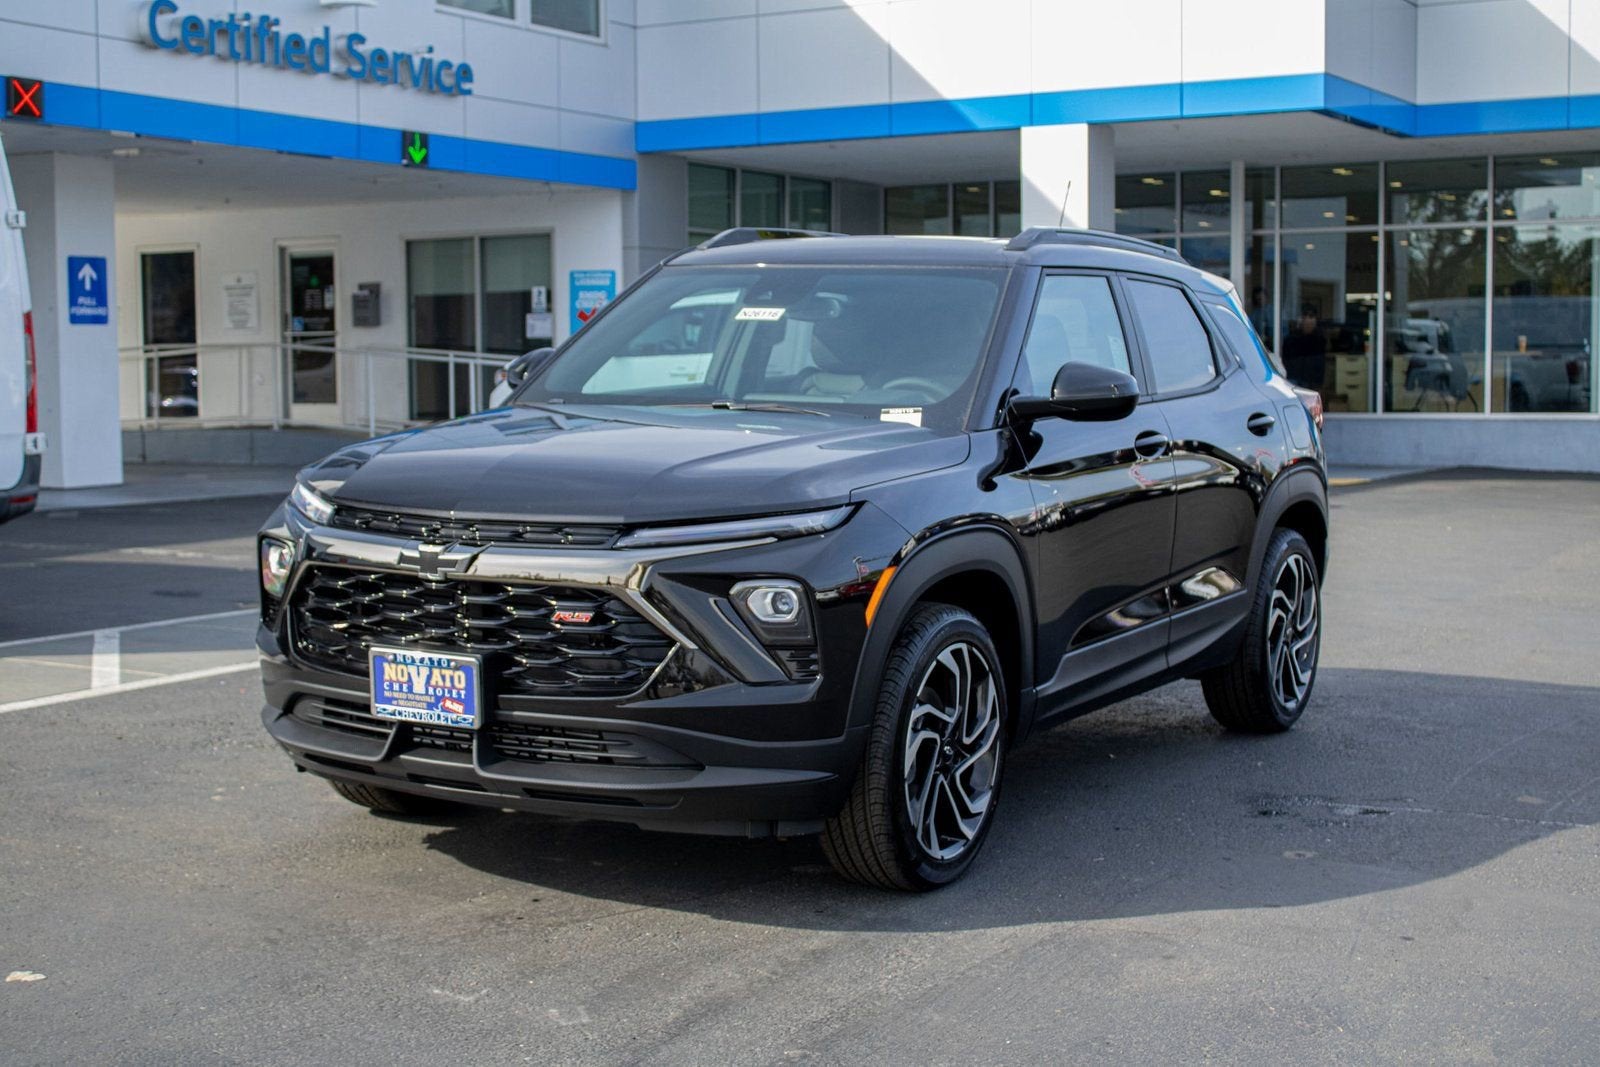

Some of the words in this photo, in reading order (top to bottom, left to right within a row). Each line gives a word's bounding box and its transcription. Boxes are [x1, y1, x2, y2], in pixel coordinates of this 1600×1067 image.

[148, 0, 331, 74] Certified
[344, 32, 475, 96] Service
[551, 611, 592, 623] RS
[396, 653, 448, 667] NOVATO
[383, 662, 466, 694] NOVATO
[394, 708, 452, 725] CHEVROLET
